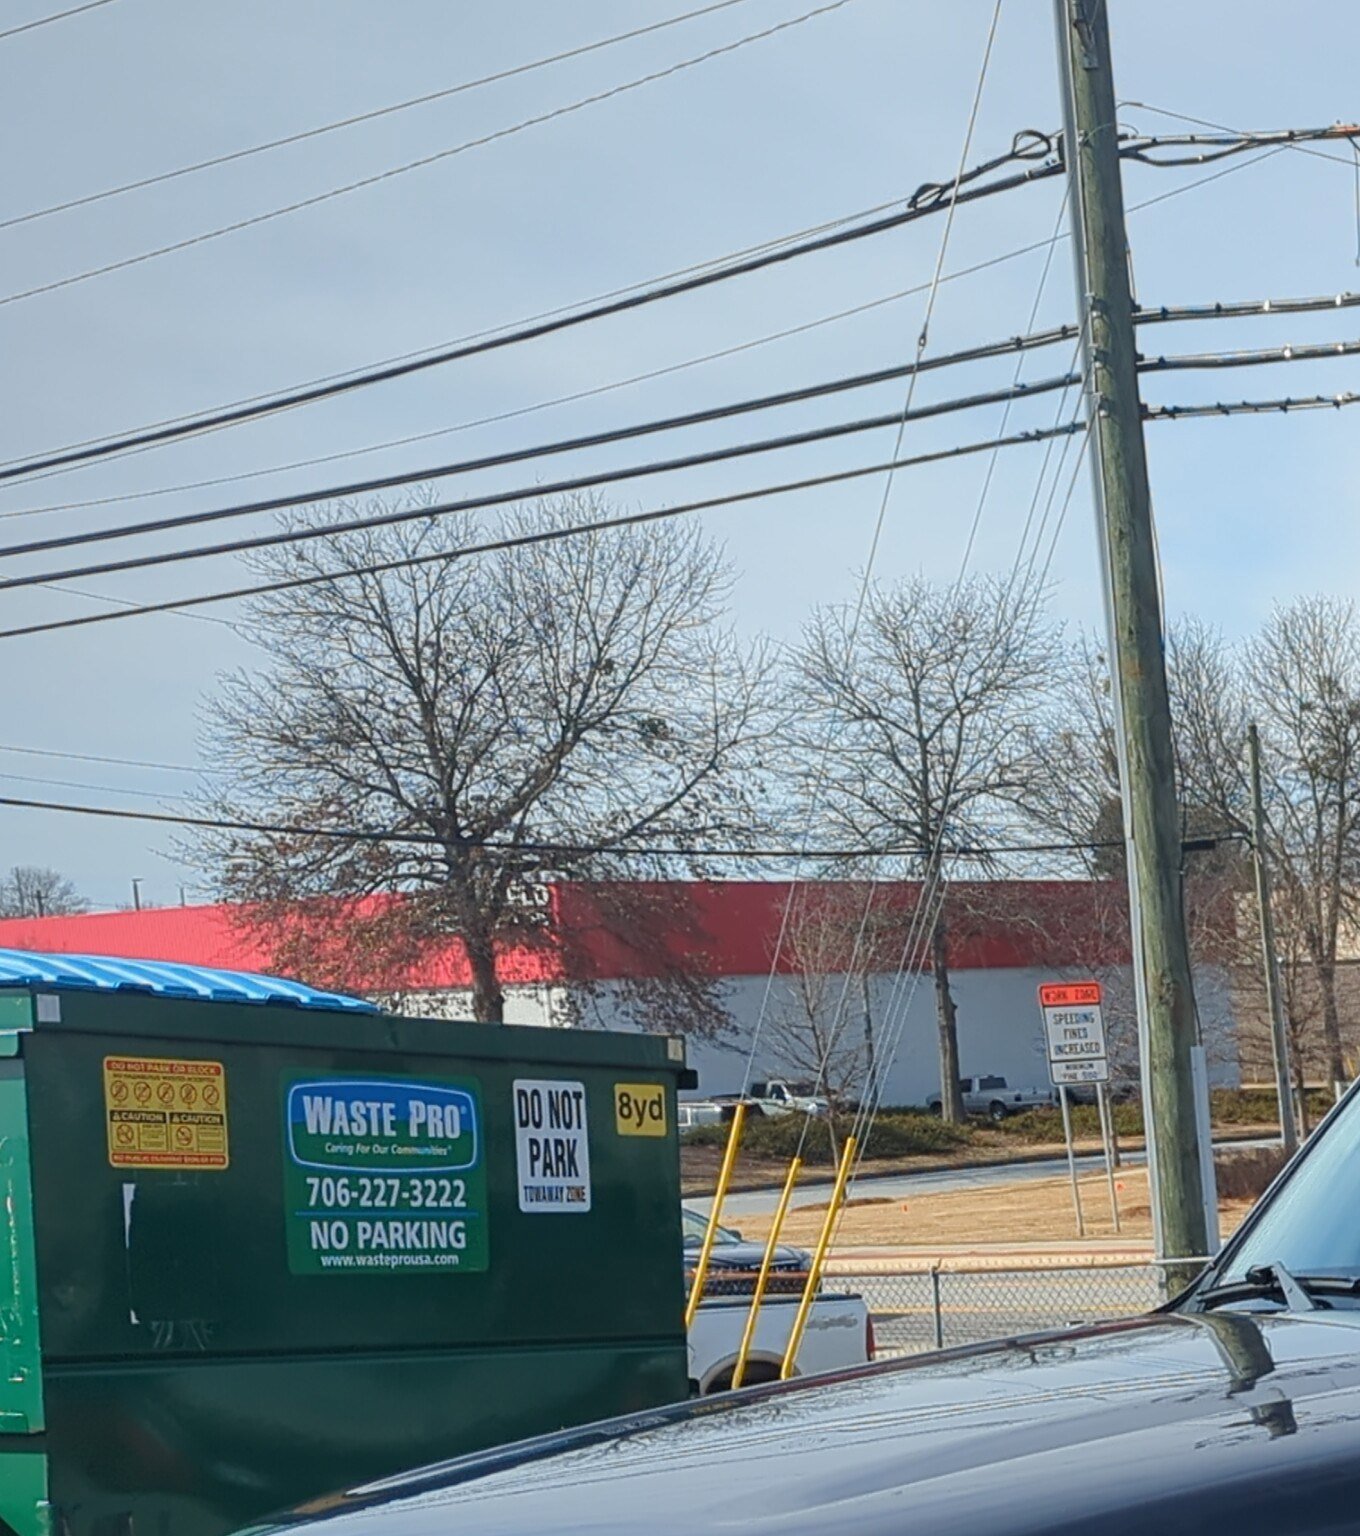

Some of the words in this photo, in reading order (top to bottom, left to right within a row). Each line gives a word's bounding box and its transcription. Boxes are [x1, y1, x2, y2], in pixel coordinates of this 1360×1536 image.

[121, 1112, 164, 1121] CAUTION
[180, 1114, 220, 1124] CAUTION
[302, 1095, 397, 1138] WASTE
[516, 1088, 543, 1129] DO
[548, 1089, 583, 1130] NOT
[618, 1092, 663, 1129] 8yd
[325, 1142, 354, 1156] Caring
[356, 1143, 371, 1154] For
[373, 1144, 389, 1154] Our
[528, 1138, 579, 1178] PARK
[306, 1177, 467, 1208] 706-227-3222
[310, 1221, 349, 1250] NO
[357, 1221, 467, 1250] PARKING
[320, 1252, 459, 1269] www.wasteprousa.com
